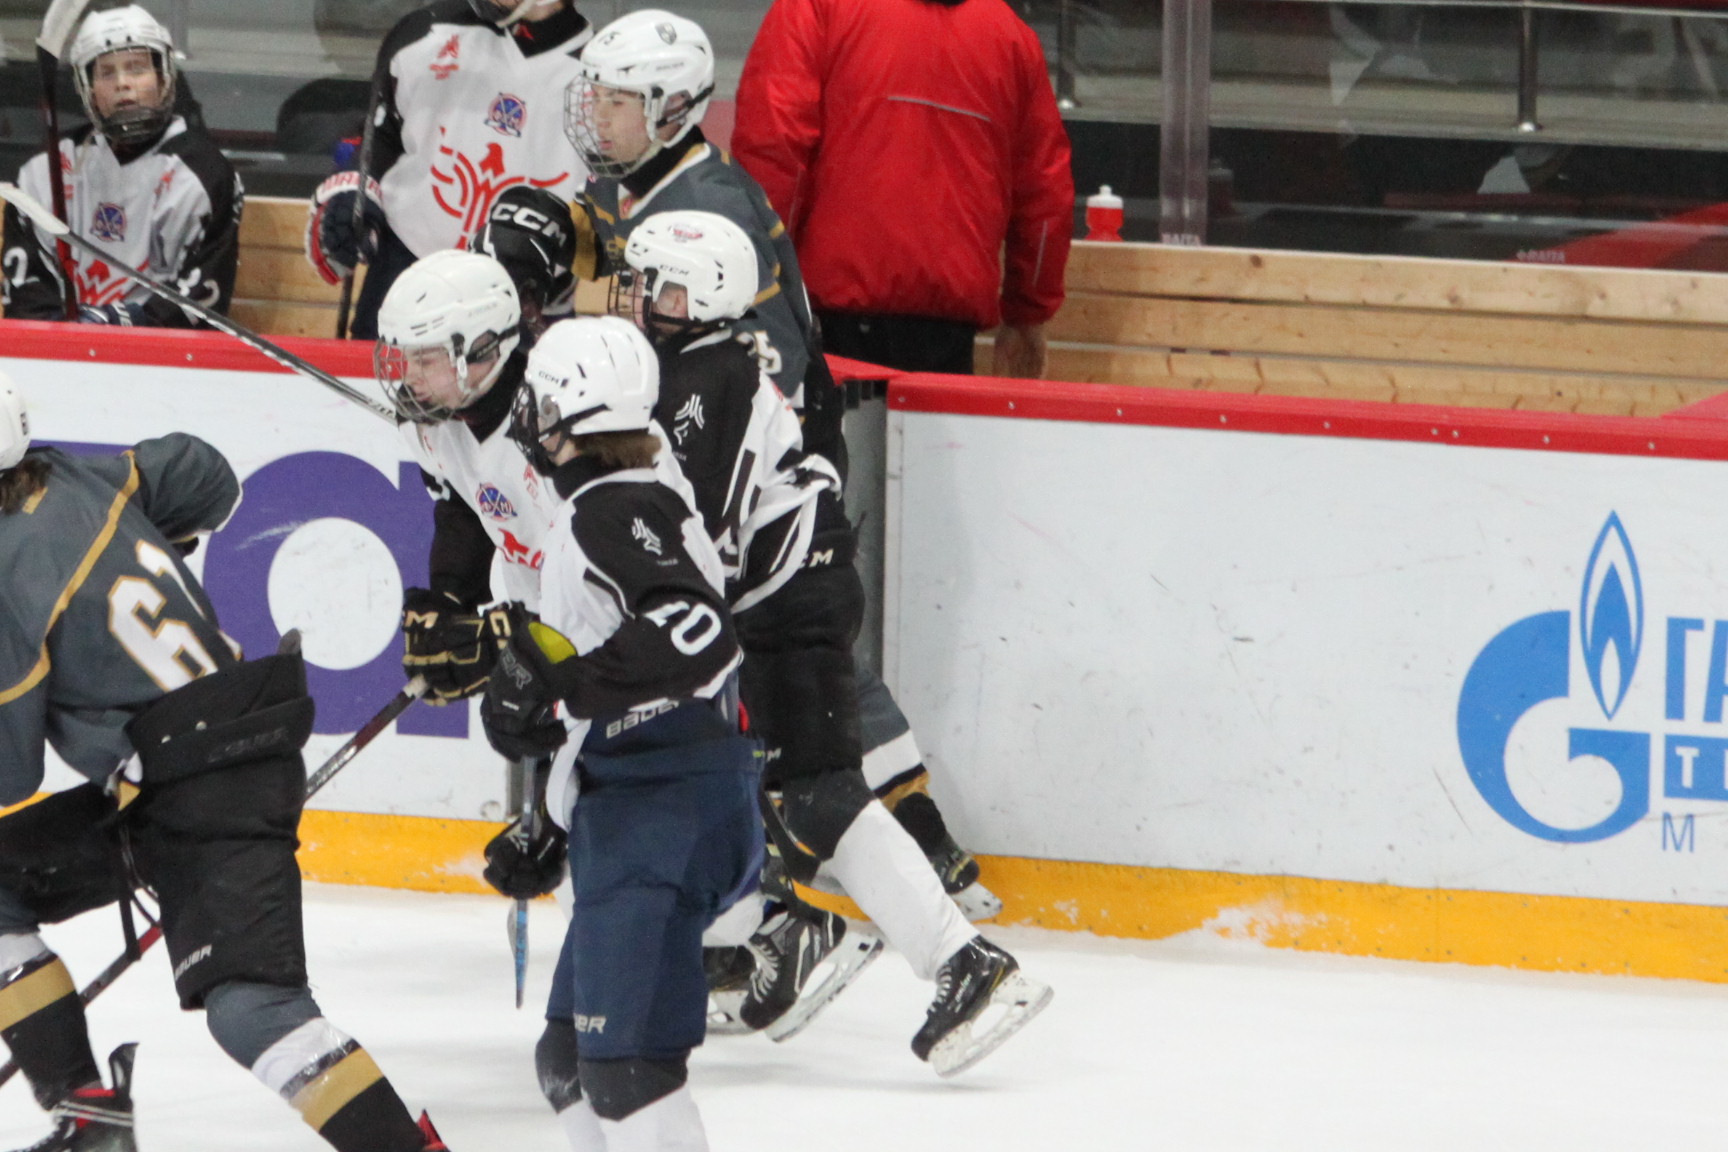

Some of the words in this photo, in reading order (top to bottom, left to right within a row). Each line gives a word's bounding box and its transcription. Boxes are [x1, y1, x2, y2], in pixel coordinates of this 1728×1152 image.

[491, 202, 567, 247] CCM
[659, 263, 690, 277] CCM
[538, 370, 561, 385] CCM
